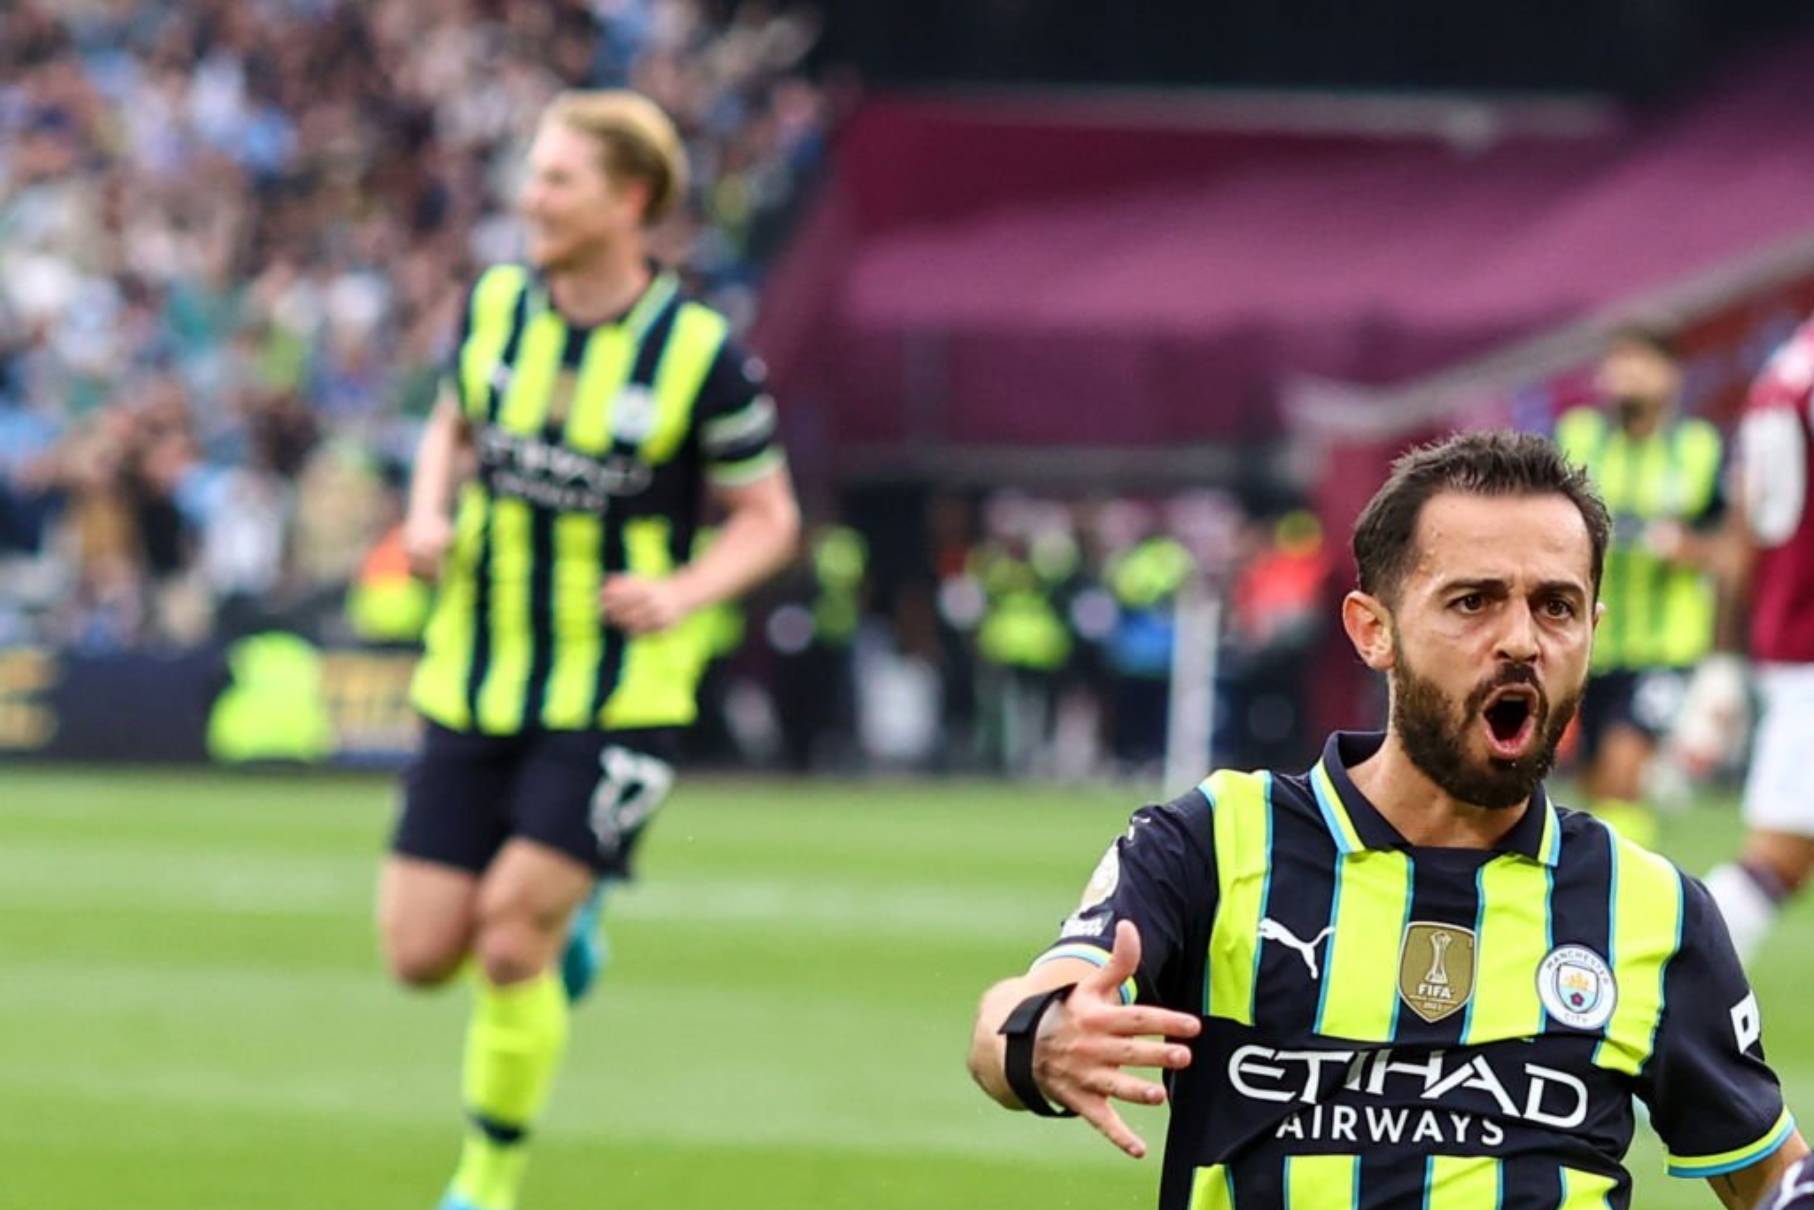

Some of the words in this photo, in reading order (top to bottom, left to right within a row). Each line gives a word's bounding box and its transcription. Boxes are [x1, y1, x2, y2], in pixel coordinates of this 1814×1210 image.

[1418, 983, 1452, 1000] FIFA
[1227, 1044, 1588, 1128] ETIHAD
[1275, 1104, 1504, 1146] AIRWAYS
